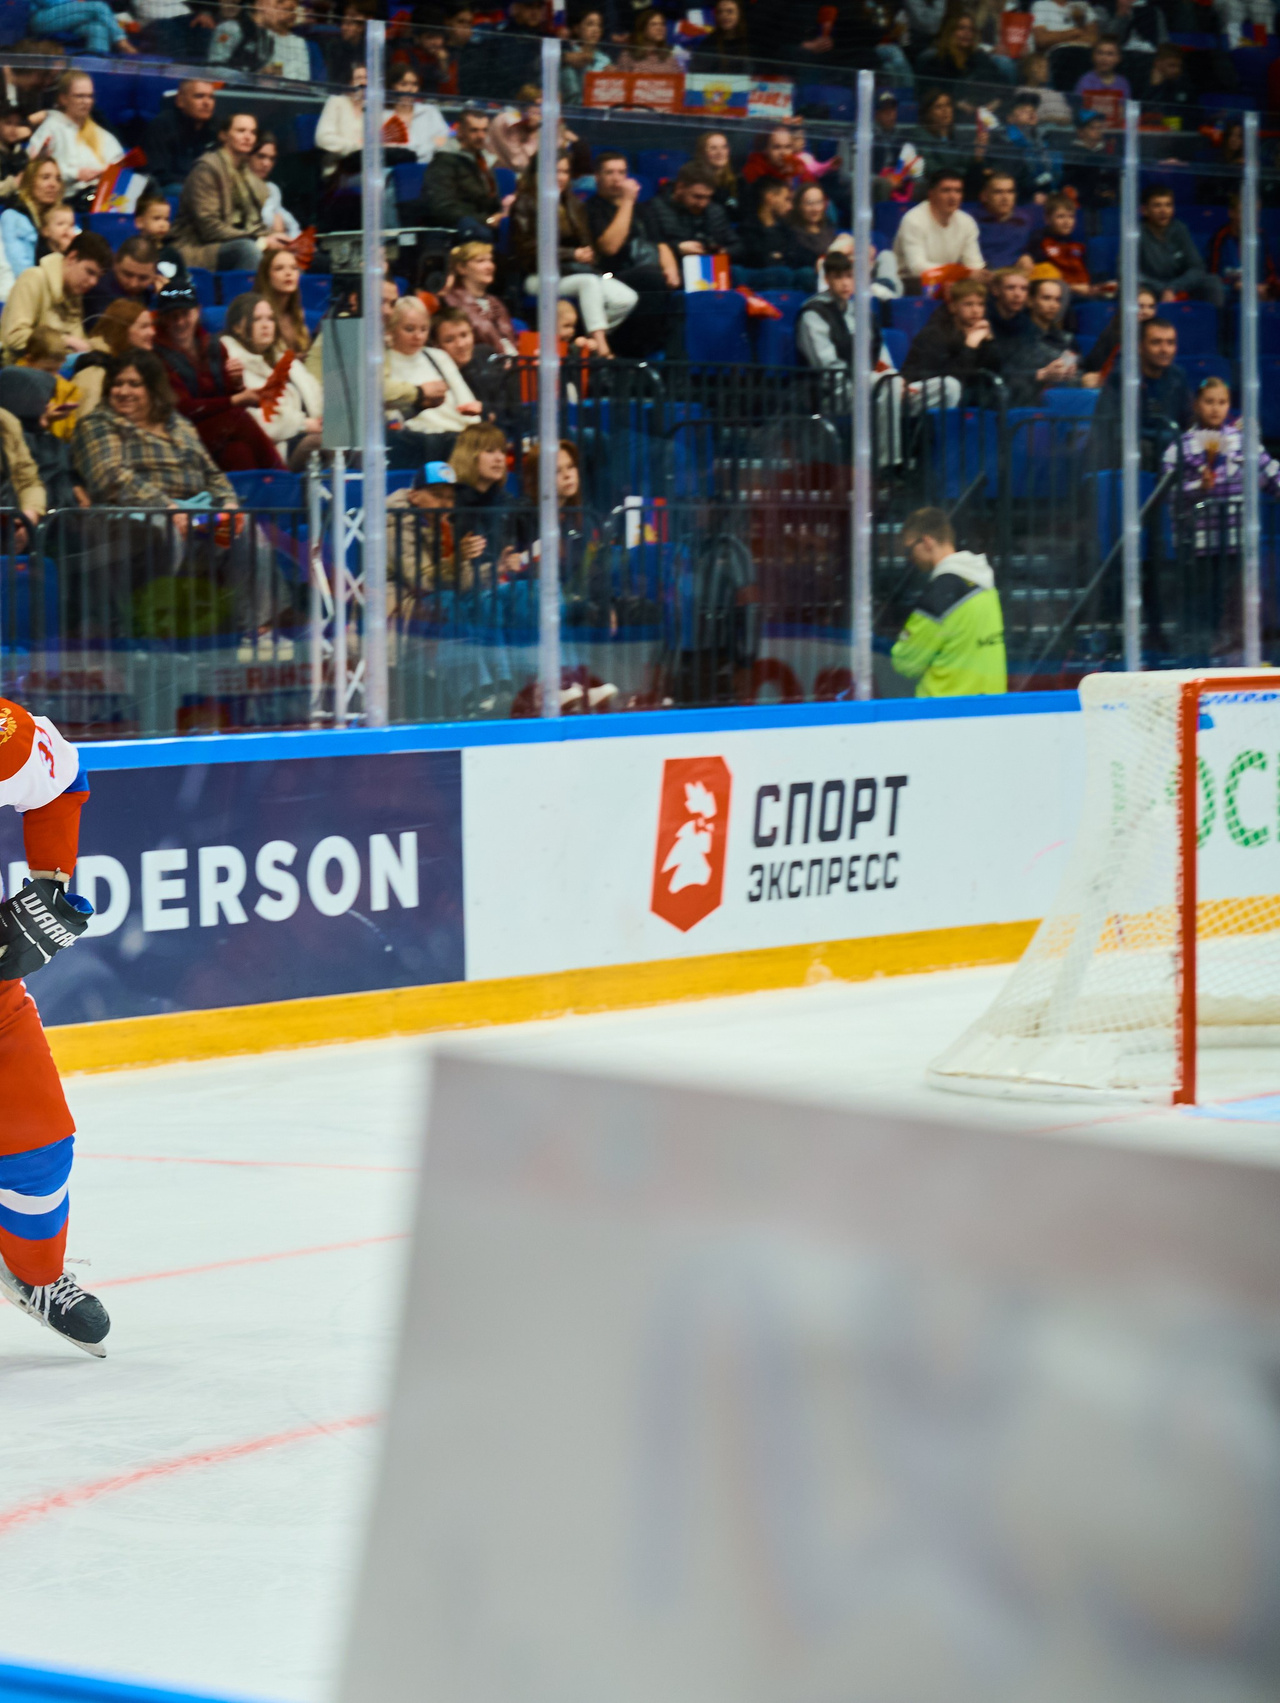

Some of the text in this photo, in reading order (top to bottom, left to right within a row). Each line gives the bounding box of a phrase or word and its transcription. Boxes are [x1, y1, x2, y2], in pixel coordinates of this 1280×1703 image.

[753, 775, 909, 848] СПОРТ
[747, 852, 900, 902] ЭКСПРЕСС
[20, 892, 80, 948] WARR
